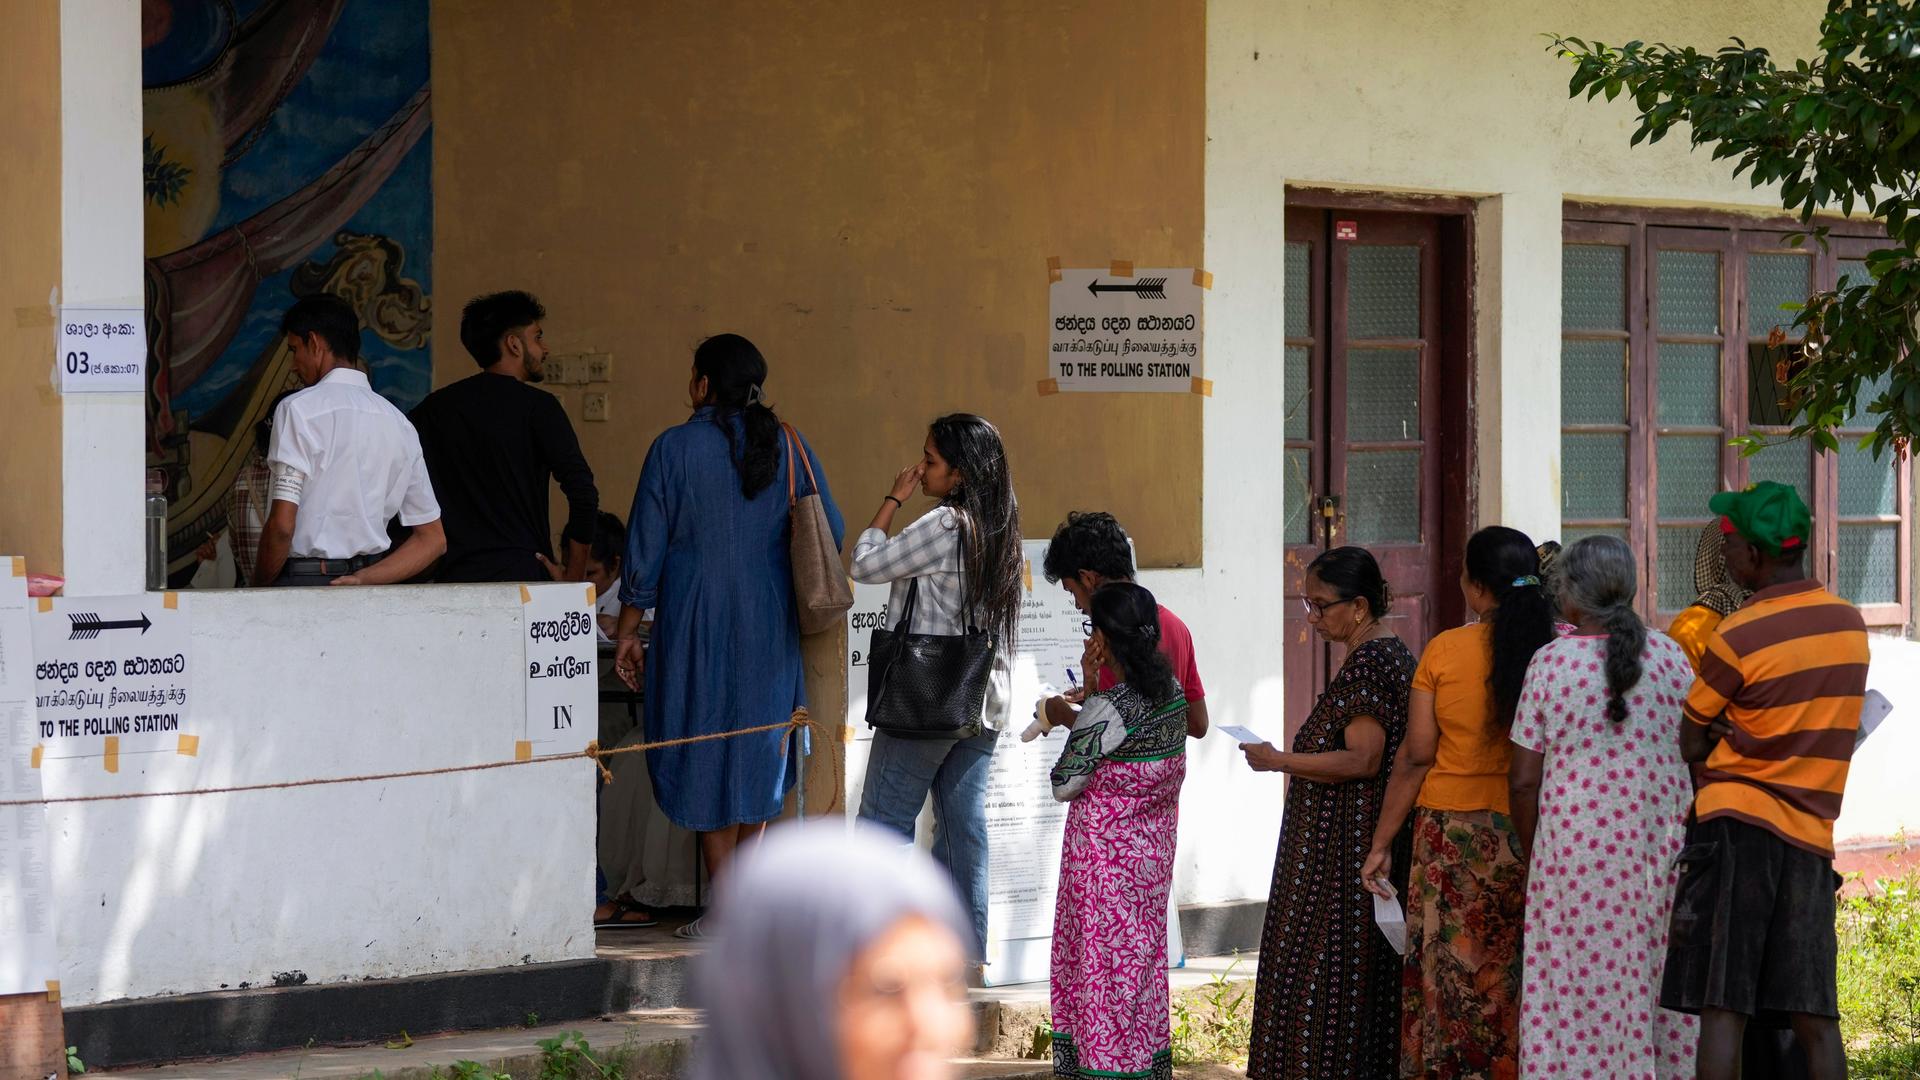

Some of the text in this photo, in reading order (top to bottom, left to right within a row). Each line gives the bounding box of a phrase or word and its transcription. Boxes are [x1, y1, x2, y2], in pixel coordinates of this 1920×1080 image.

[65, 322, 99, 338] ශාලා
[1101, 315, 1131, 335] දෙන
[1052, 338, 1197, 357] வாக்கெடுப்பு நிலையத்துக்கு
[1060, 362, 1190, 378] TO THE POLLING STATION
[530, 611, 592, 644] ඇතුල්වීම
[85, 660, 117, 683] දෙන
[529, 656, 591, 679] உள்ளே
[36, 684, 186, 710] வாக்கெடுப்பு நிலையத்துக்கு
[40, 720, 54, 738] TO
[58, 719, 80, 737] THE
[84, 716, 130, 736] POLLING
[134, 713, 179, 733] STATION
[553, 704, 573, 730] IN
